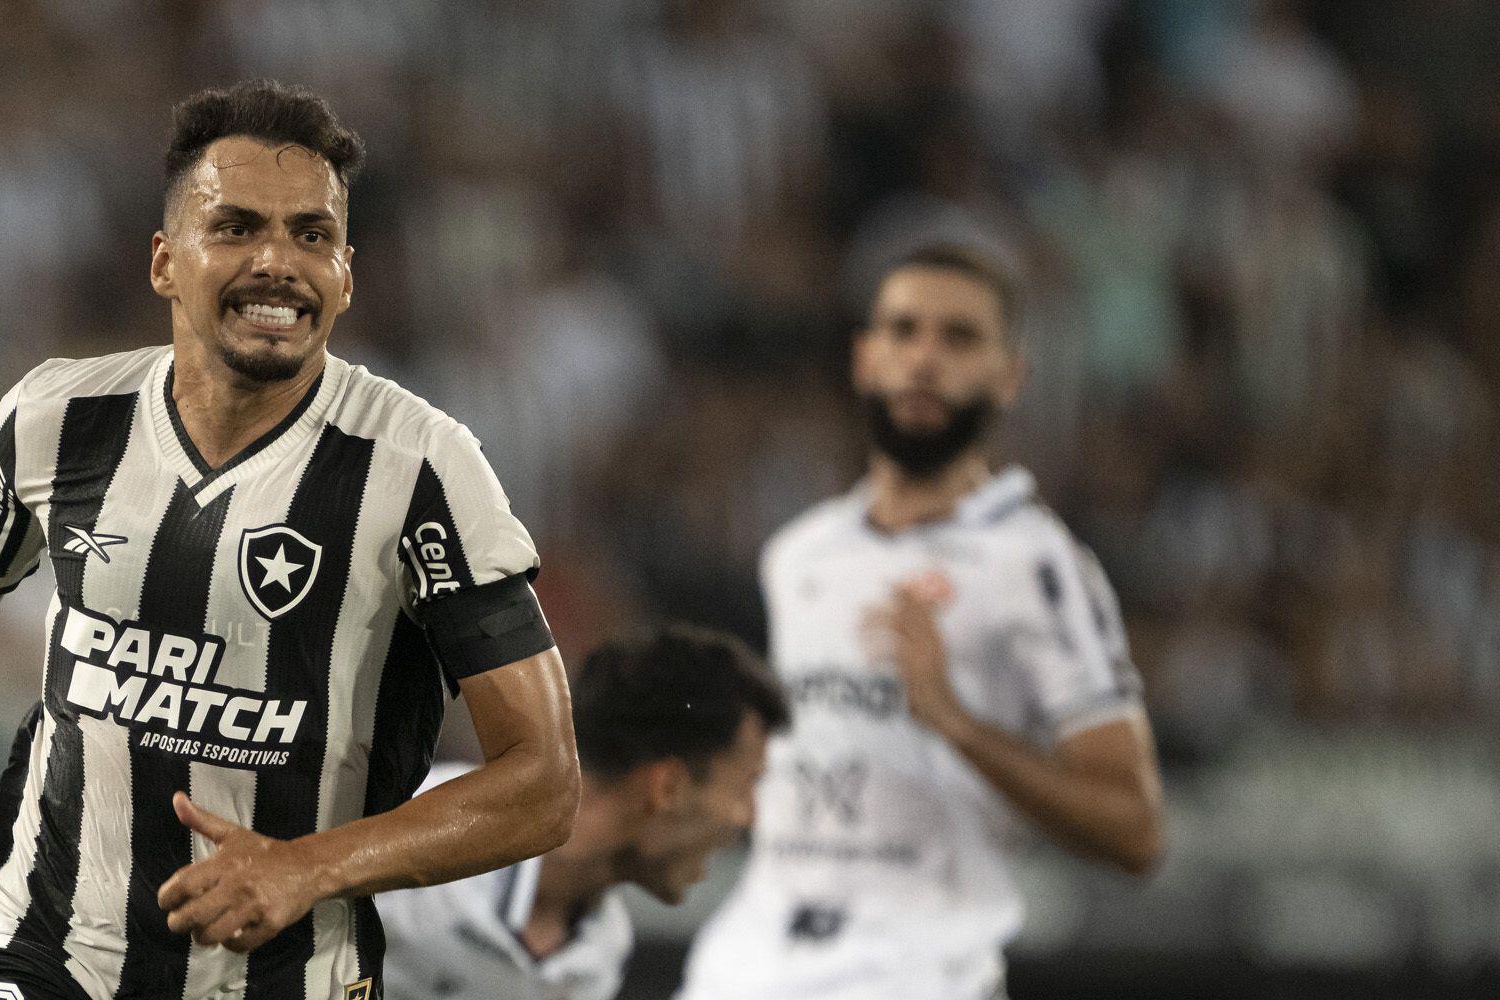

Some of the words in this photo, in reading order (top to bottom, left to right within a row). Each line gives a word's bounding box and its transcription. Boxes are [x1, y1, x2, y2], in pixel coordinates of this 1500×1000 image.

[60, 606, 219, 685] PARI
[66, 660, 308, 744] MATCH
[139, 731, 202, 756] APOSTAS
[201, 743, 290, 766] ESPORTIVAS
